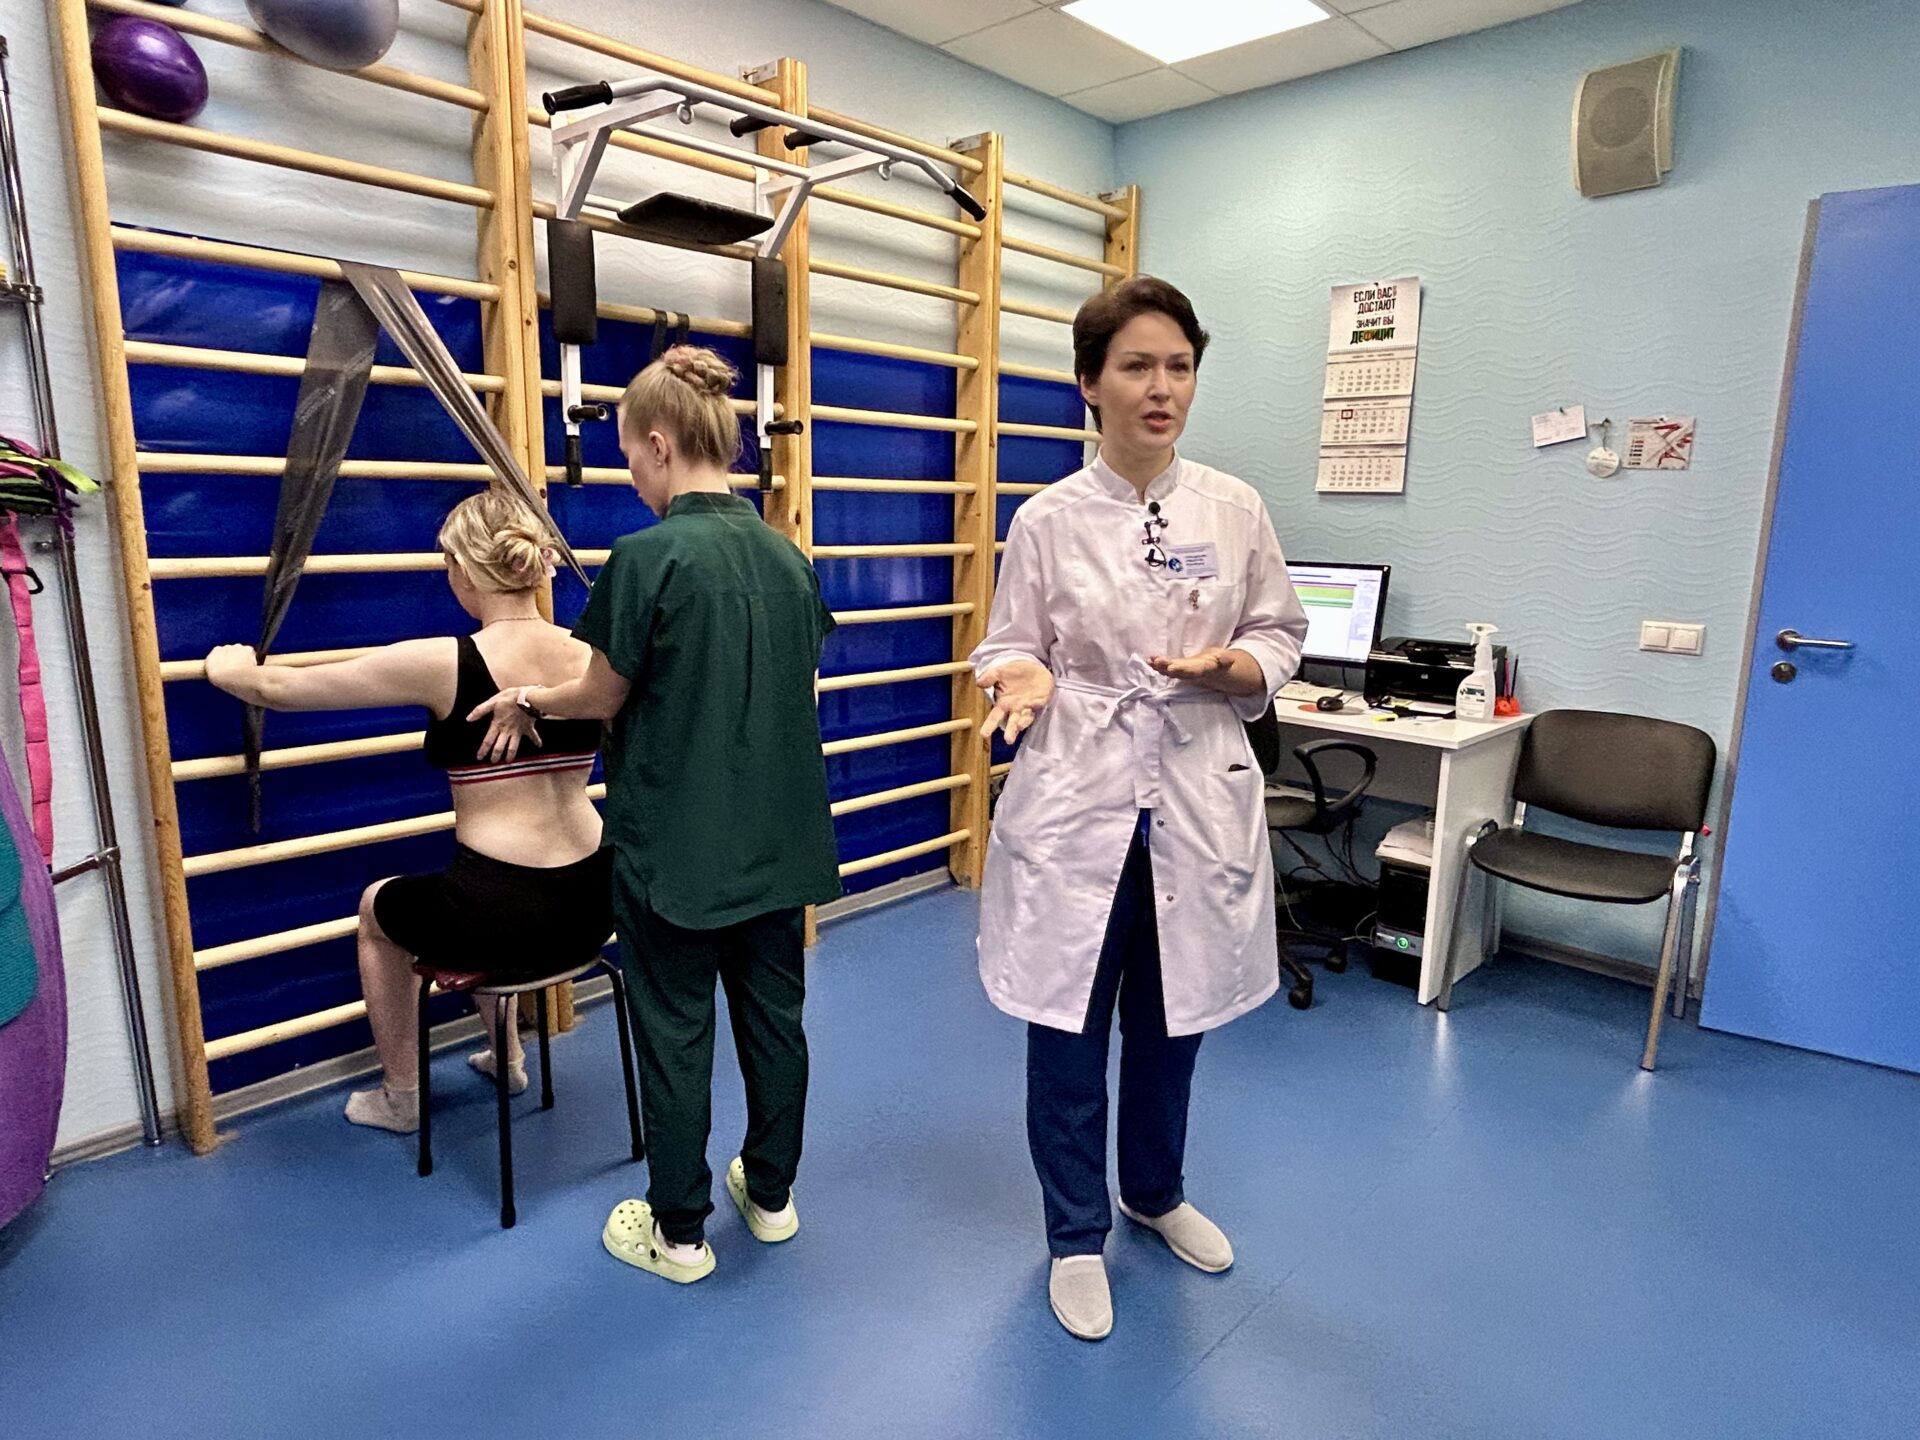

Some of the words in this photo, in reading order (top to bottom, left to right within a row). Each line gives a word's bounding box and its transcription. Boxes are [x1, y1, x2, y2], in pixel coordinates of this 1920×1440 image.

[1354, 290, 1376, 303] ЕСЛИ
[1357, 298, 1397, 315] ДОСТАЮТ
[1356, 317, 1381, 329] ЗНАЧИТ
[1383, 315, 1394, 326] ВЫ
[1350, 327, 1396, 345] ДЕФИЦИТ
